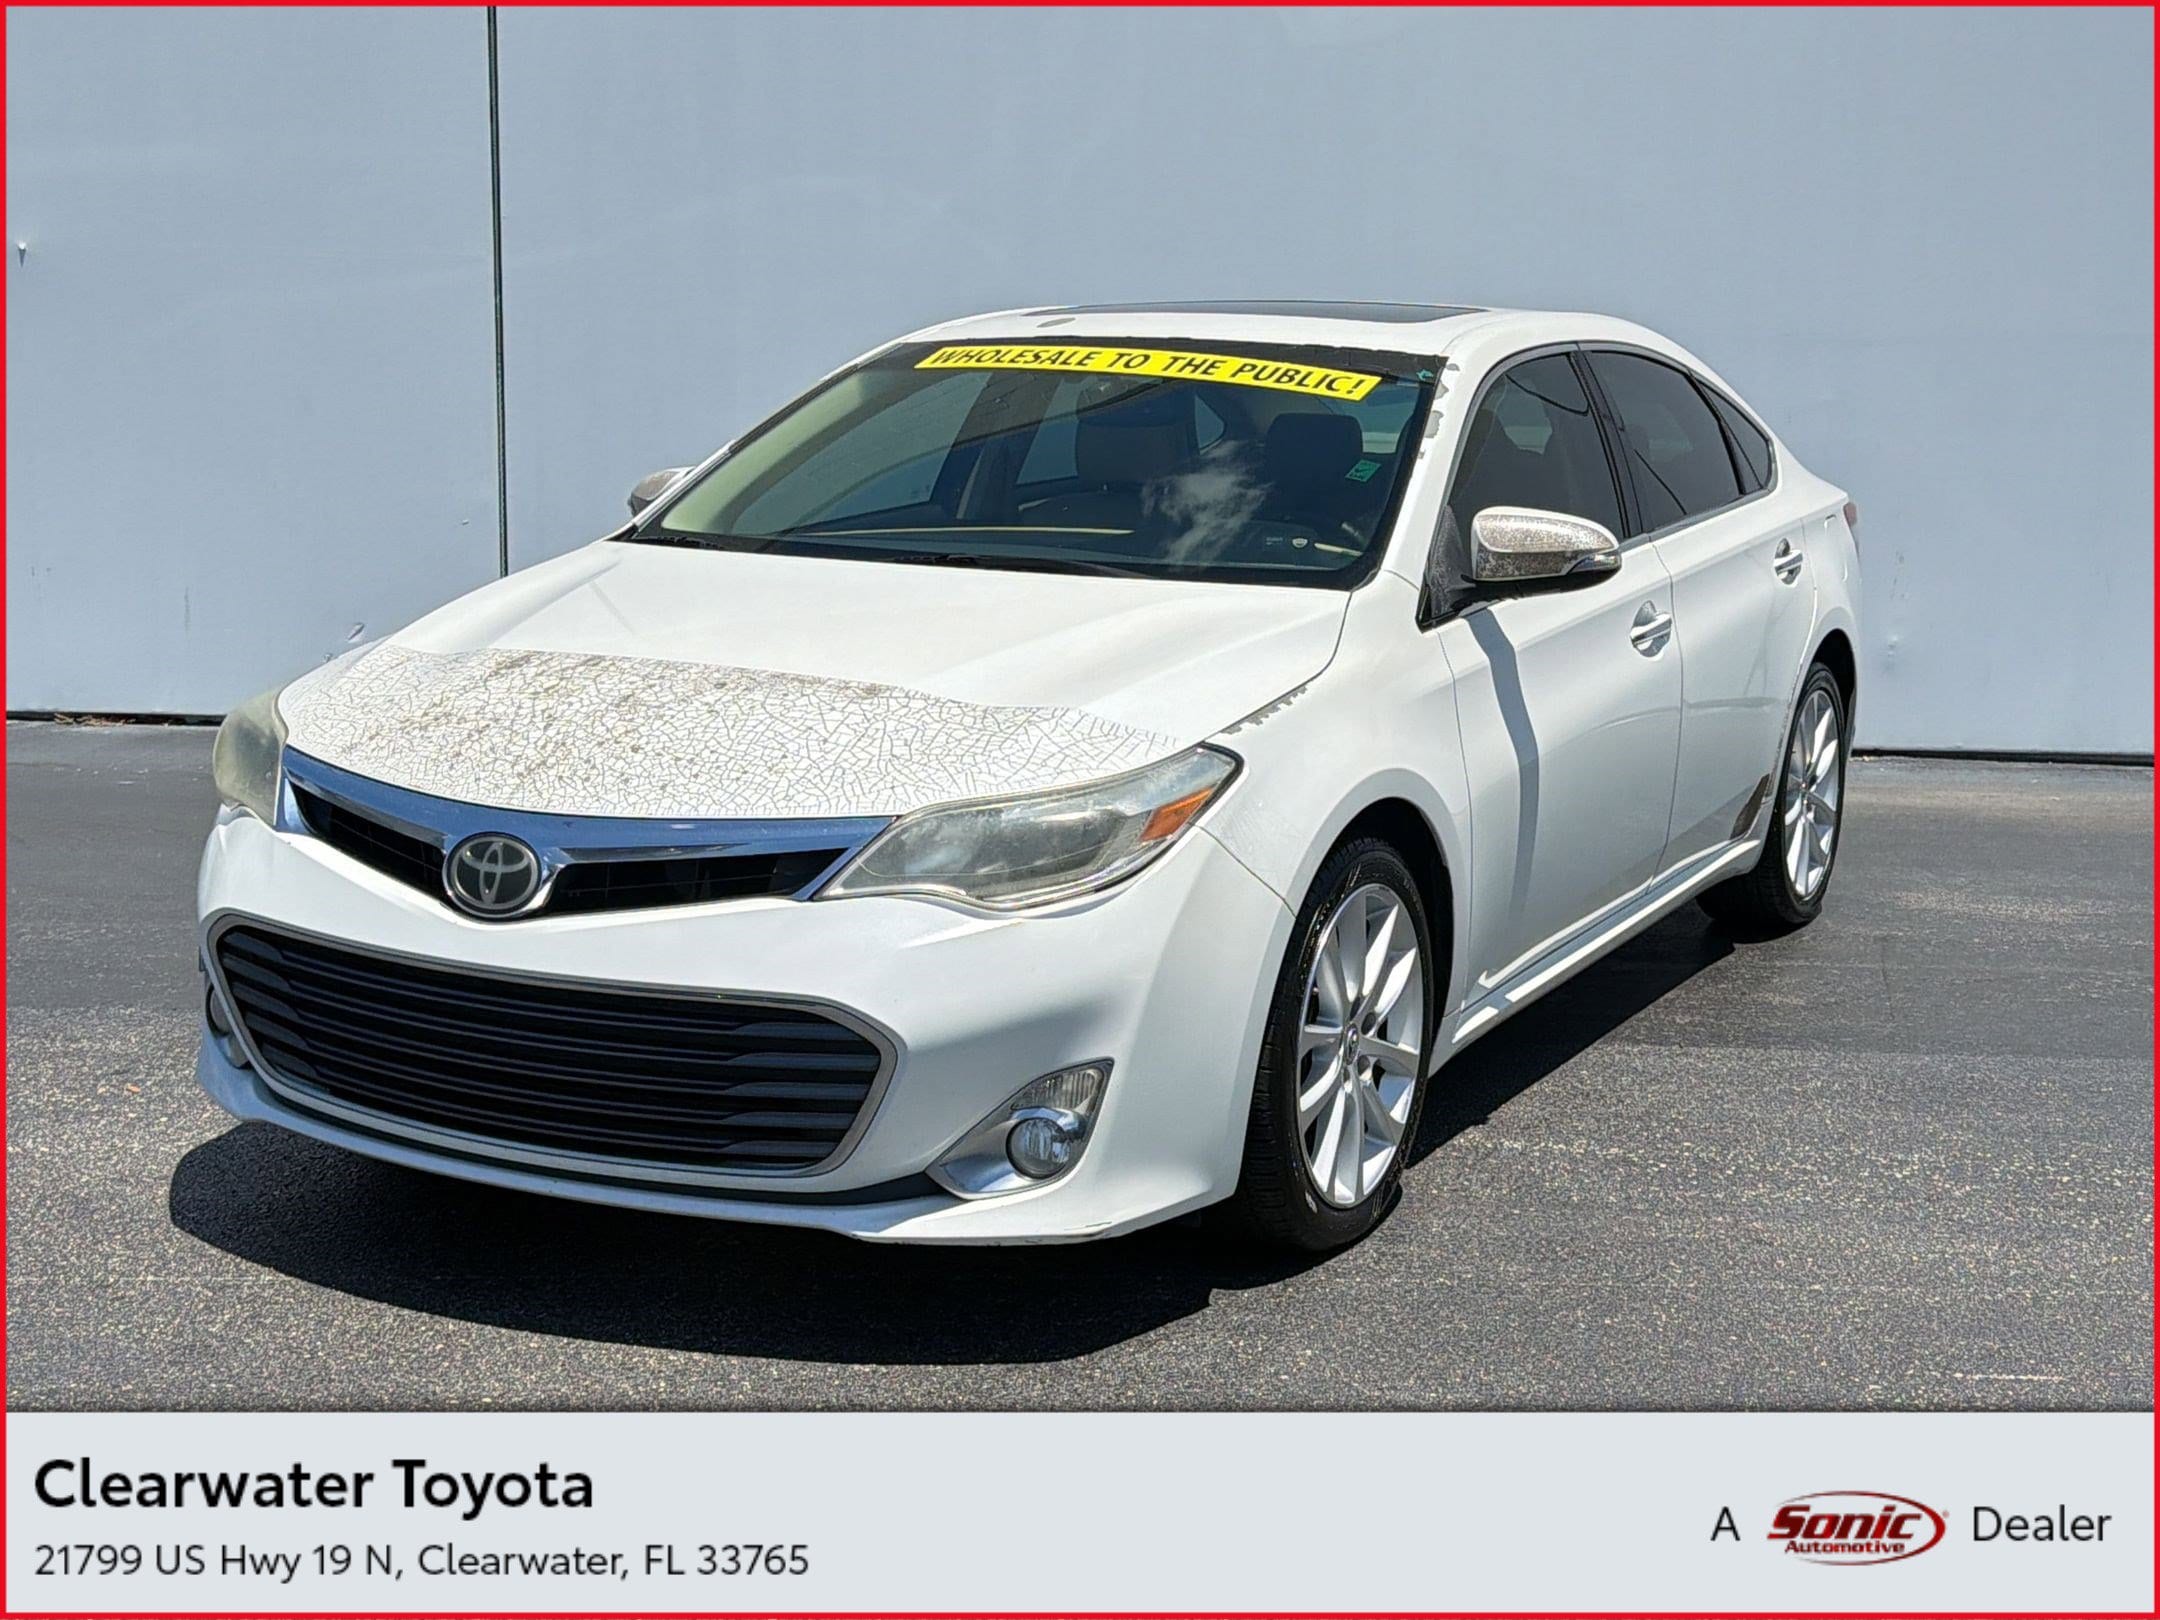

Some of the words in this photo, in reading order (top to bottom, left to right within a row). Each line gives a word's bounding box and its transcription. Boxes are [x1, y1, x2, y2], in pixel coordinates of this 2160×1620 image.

[930, 349, 1102, 368] WHOLESALE
[1107, 352, 1151, 370] TO
[1161, 356, 1227, 376] THE
[1230, 363, 1366, 395] PUBLIC!
